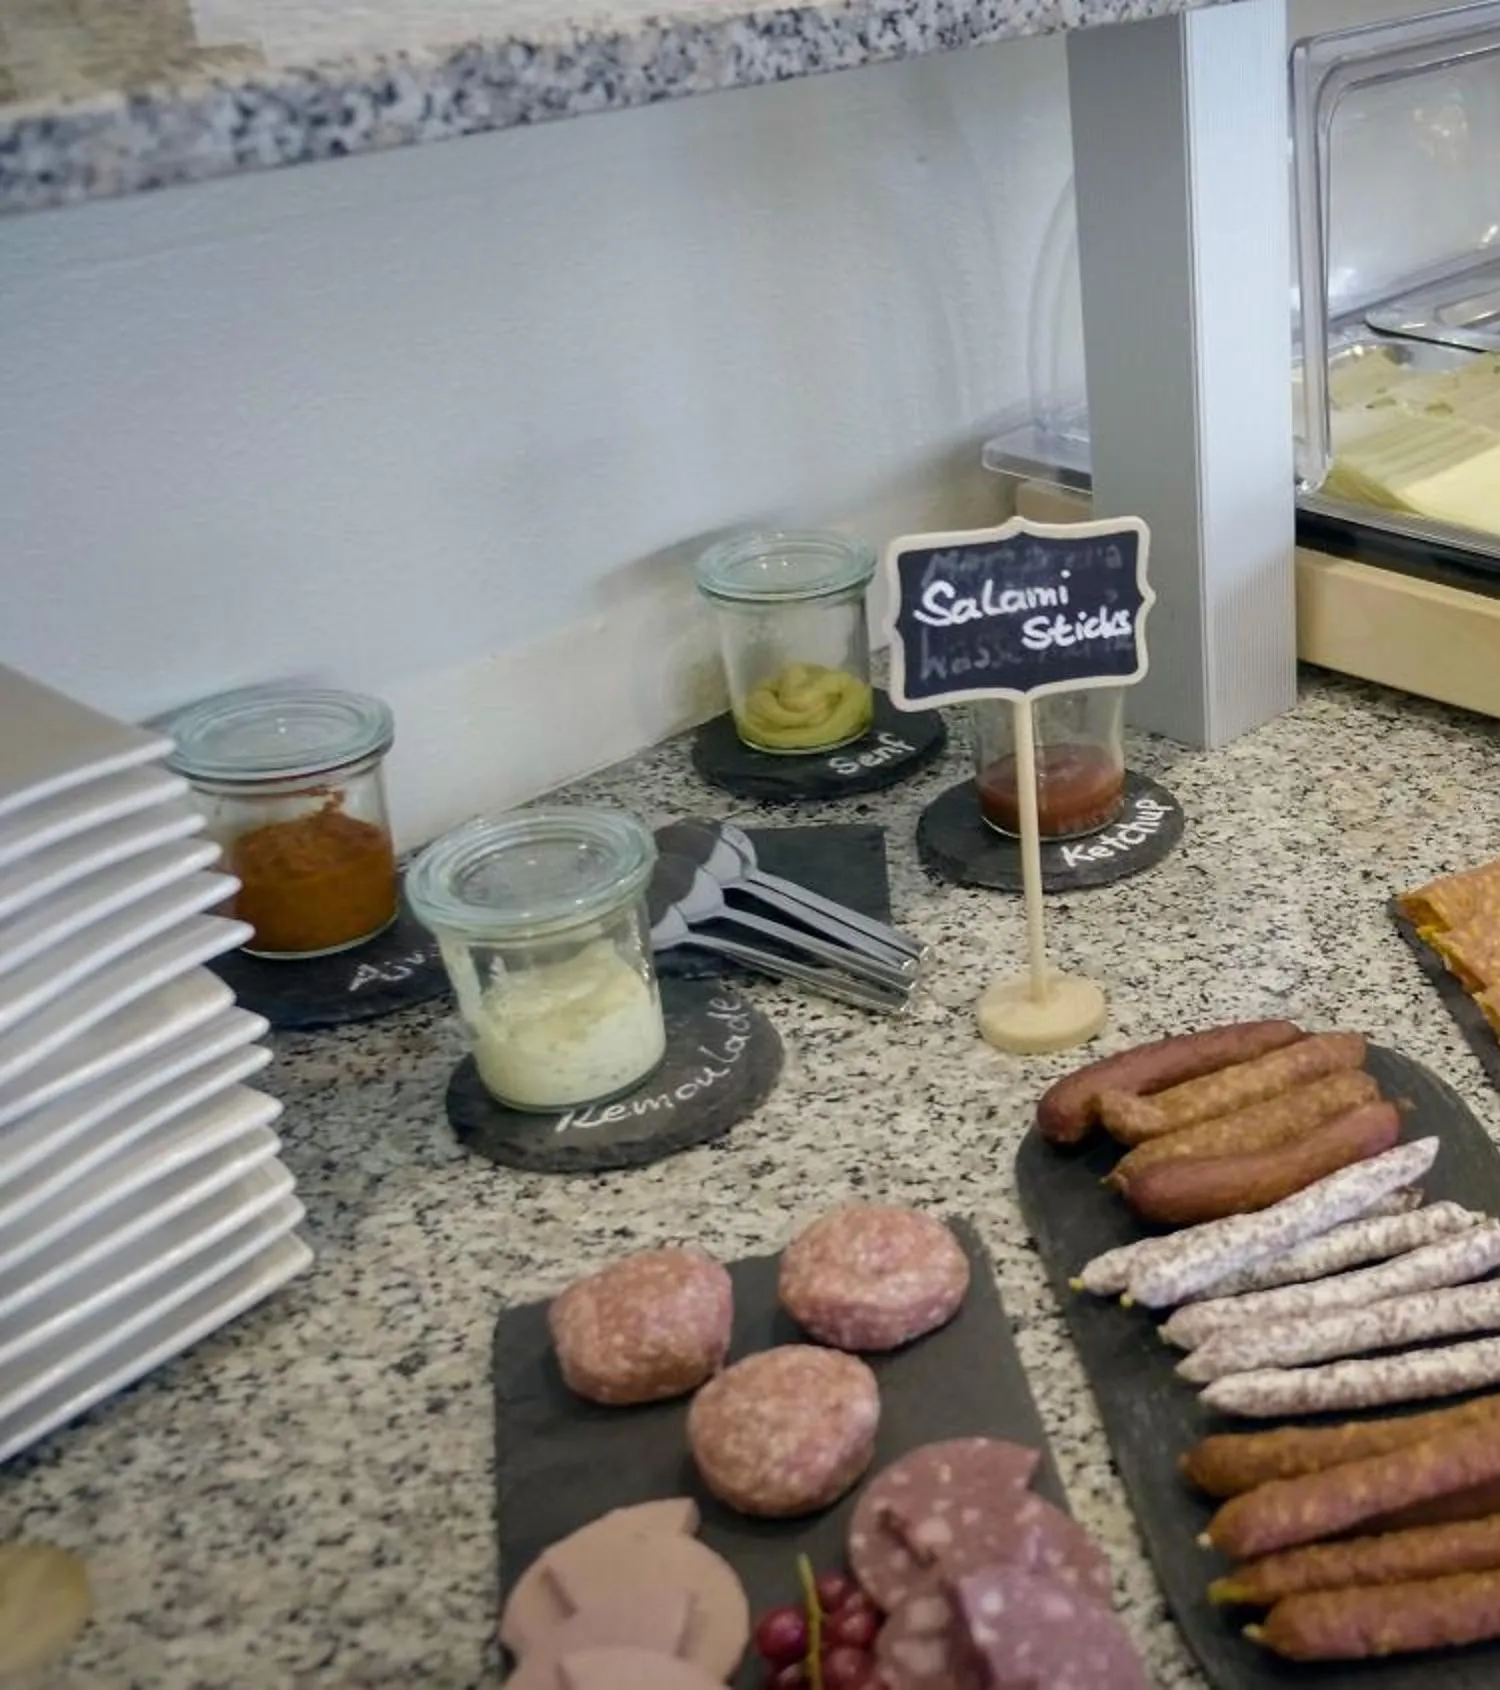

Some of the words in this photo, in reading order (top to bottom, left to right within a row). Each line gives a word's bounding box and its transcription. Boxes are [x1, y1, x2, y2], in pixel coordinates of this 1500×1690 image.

[914, 569, 1070, 627] Salami
[1021, 605, 1132, 650] Sticks
[828, 732, 916, 775] Senf
[1060, 799, 1174, 868] Ketchup
